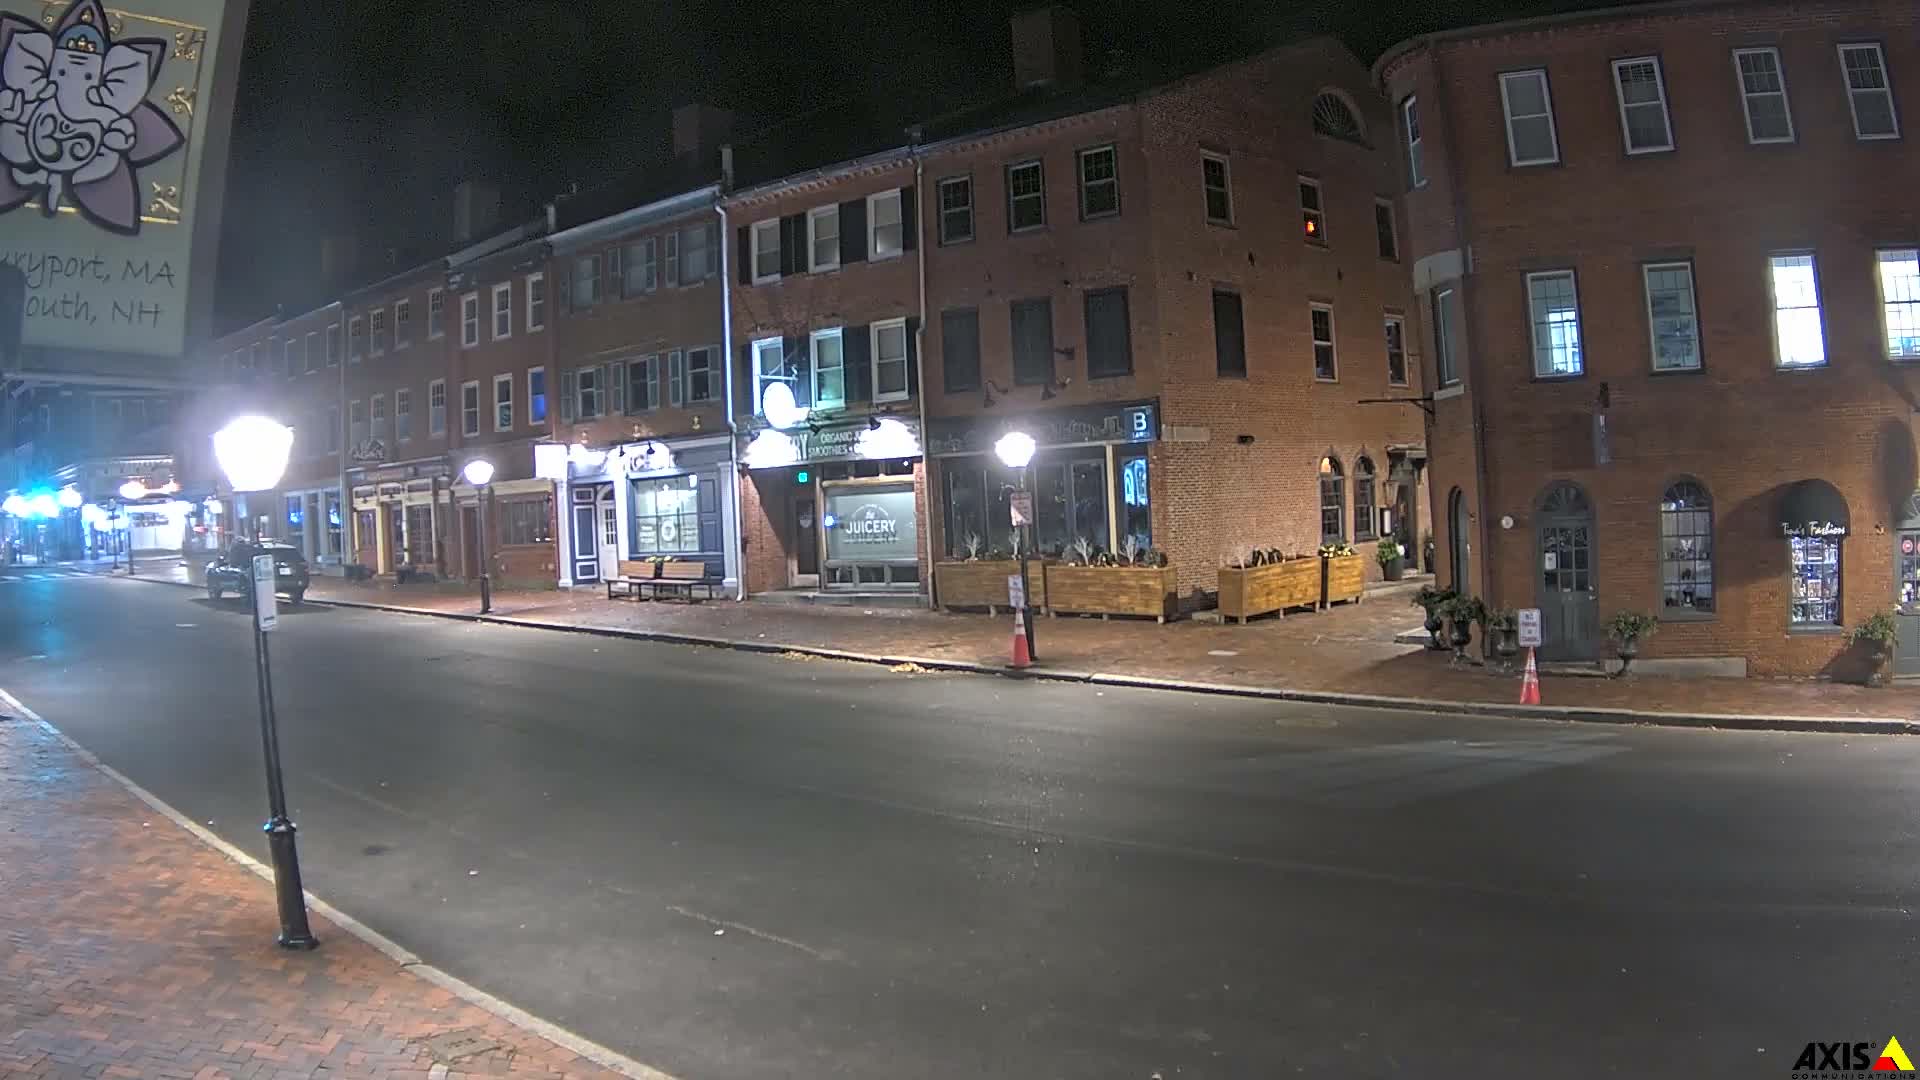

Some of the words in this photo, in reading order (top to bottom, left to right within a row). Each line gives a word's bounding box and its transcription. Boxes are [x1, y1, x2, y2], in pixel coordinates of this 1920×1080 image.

[121, 260, 175, 288] MA
[112, 300, 161, 328] NH
[1133, 411, 1147, 430] B
[820, 431, 853, 443] ORGANIC
[846, 520, 896, 534] JUICERY
